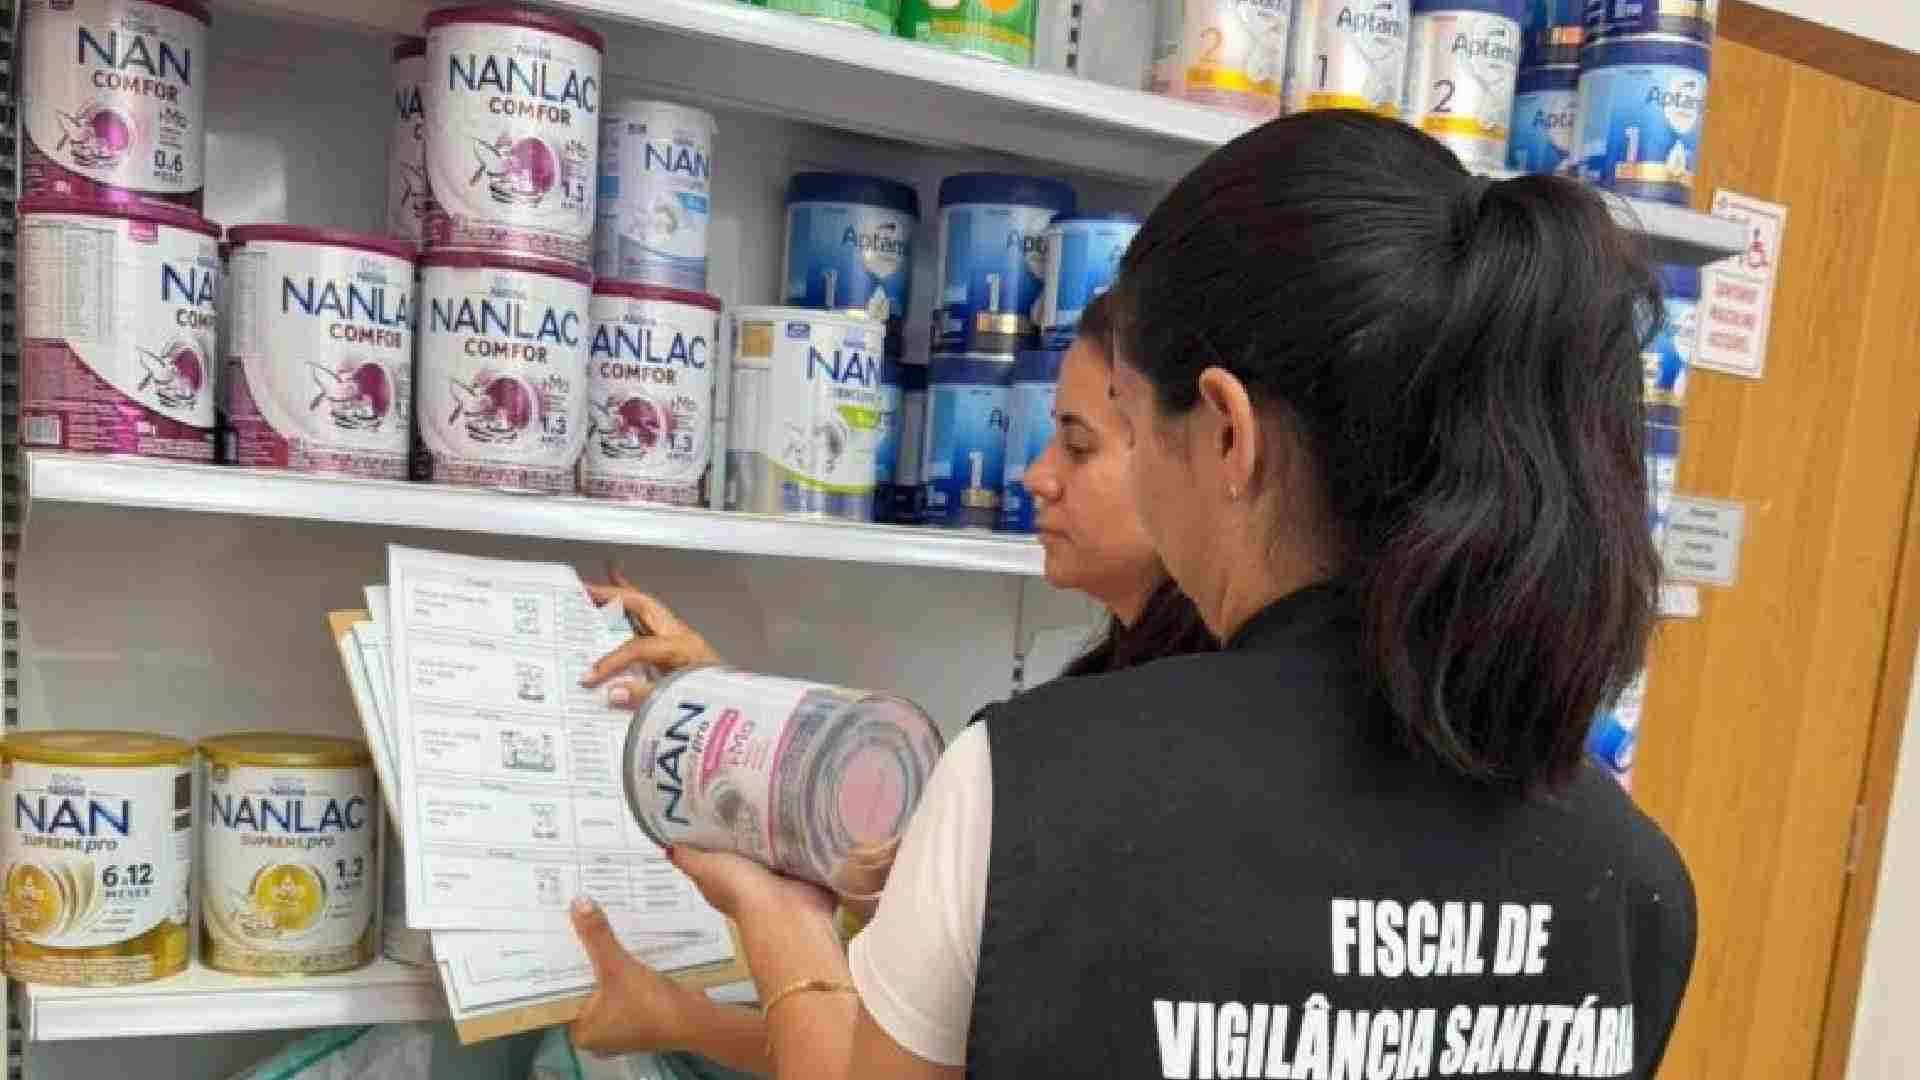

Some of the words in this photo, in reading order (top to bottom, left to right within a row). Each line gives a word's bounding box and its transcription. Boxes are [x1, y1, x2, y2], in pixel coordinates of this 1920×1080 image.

[78, 27, 190, 85] NAN
[1200, 27, 1222, 63] 2
[93, 70, 178, 104] COMFOR
[448, 54, 597, 113] NANLAC
[1315, 54, 1328, 90] 1
[489, 96, 572, 127] COMFOR
[1432, 79, 1455, 113] 2
[1624, 127, 1639, 164] 1
[985, 273, 1000, 312] 1
[431, 297, 580, 345] NANLAC
[464, 337, 548, 363] COMFOR
[591, 323, 706, 368] ANLAC
[600, 362, 675, 385] COMFOR
[807, 345, 881, 387] NAN
[968, 451, 983, 490] 1
[656, 701, 705, 825] NAN
[16, 792, 130, 836] NAN
[210, 791, 368, 833] NANLAC
[1331, 898, 1485, 977] FISCAL
[1492, 903, 1553, 977] DE
[1153, 992, 1438, 1080] VIGILÂNCIA
